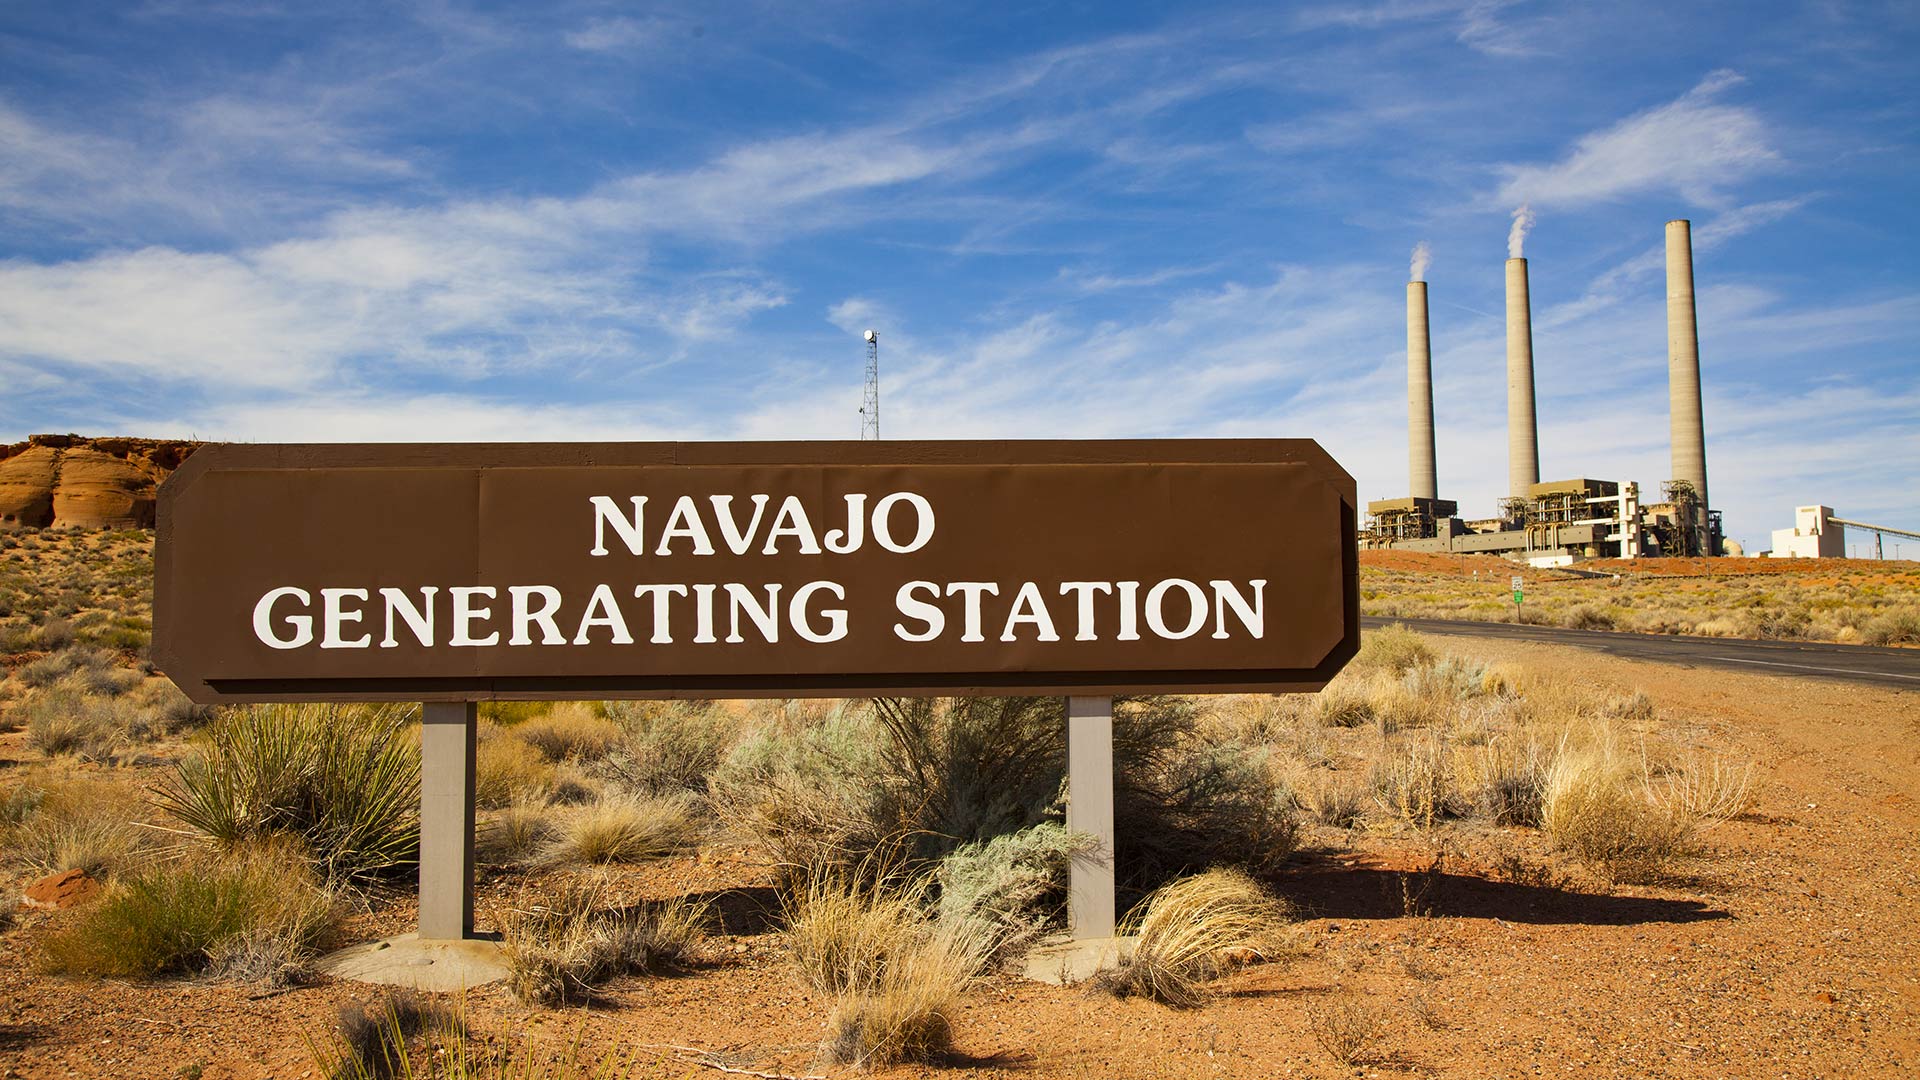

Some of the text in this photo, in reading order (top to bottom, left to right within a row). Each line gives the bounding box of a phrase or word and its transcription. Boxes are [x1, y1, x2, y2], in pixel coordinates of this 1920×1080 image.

[590, 492, 934, 556] NAVAJO
[253, 579, 1266, 649] GENERATING STATION
